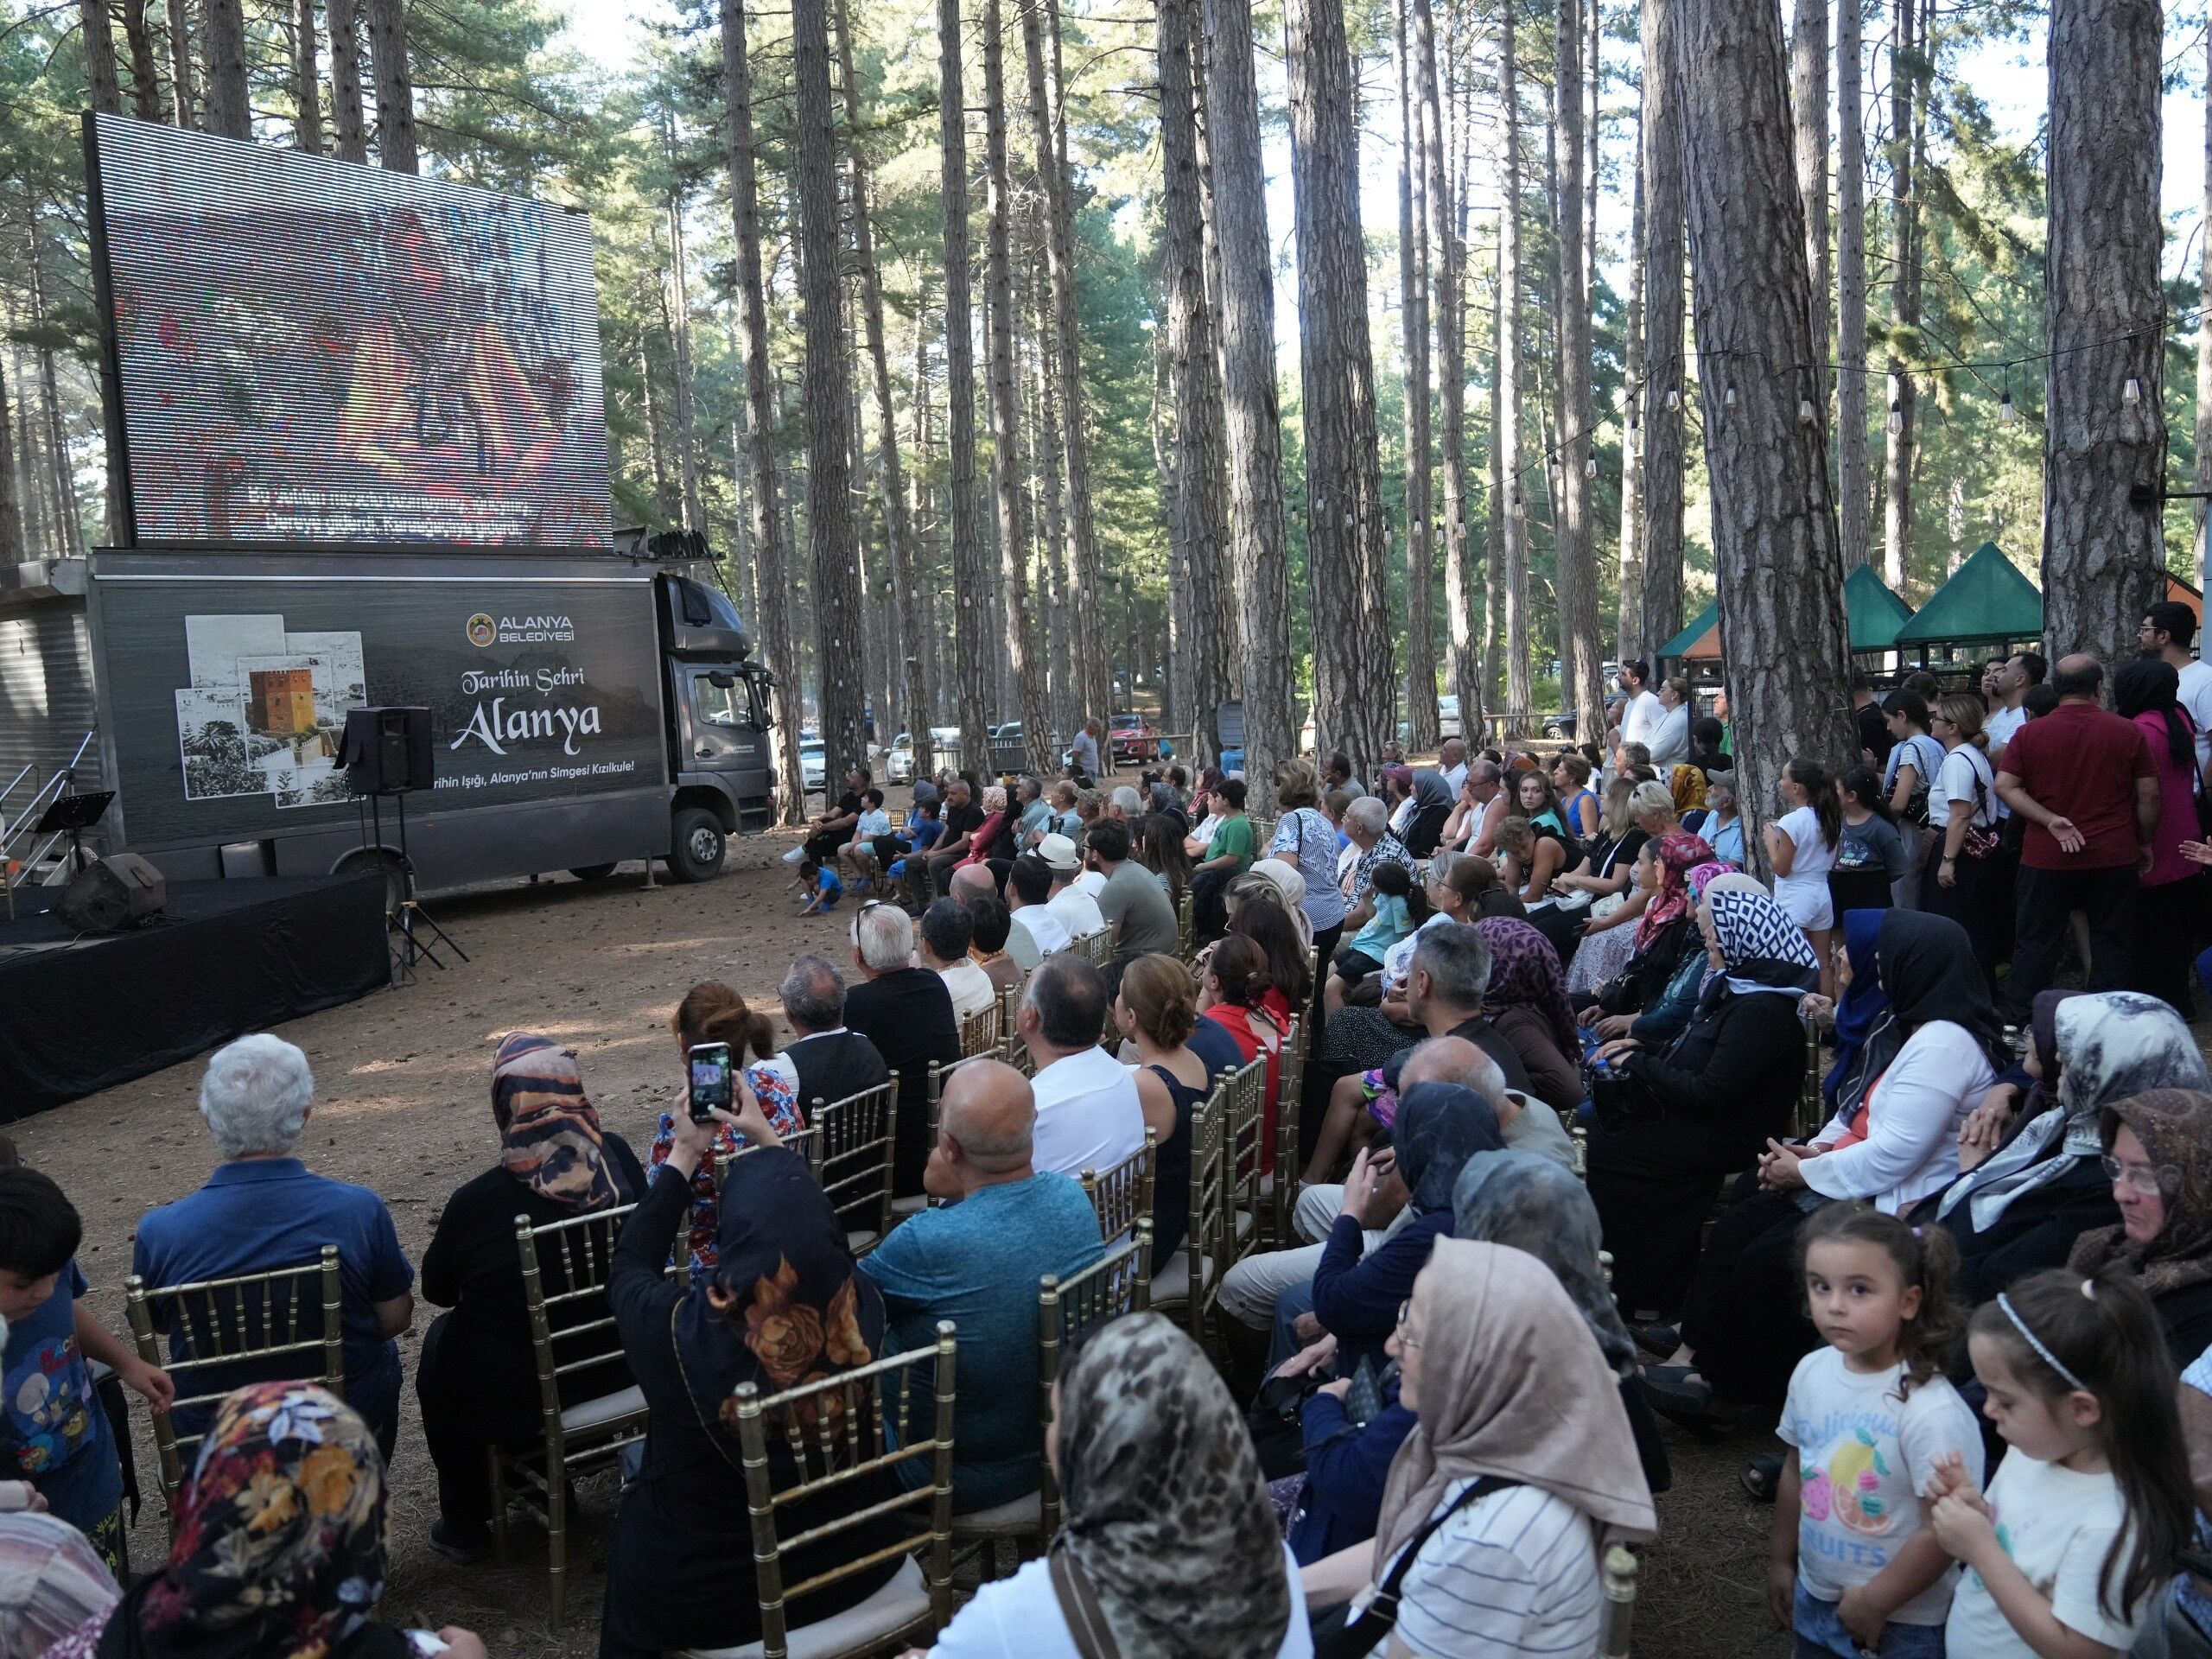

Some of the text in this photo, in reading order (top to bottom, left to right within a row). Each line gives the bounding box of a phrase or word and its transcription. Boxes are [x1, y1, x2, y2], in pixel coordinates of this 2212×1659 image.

[499, 616, 573, 630] ALANYA
[499, 630, 575, 642] BELEDİYESİ
[461, 667, 585, 696] Tarihin Şehri
[450, 697, 601, 755] Alanya
[434, 760, 634, 789] rihin Işığı, Alanya'nın Simgesi Kızılkule!
